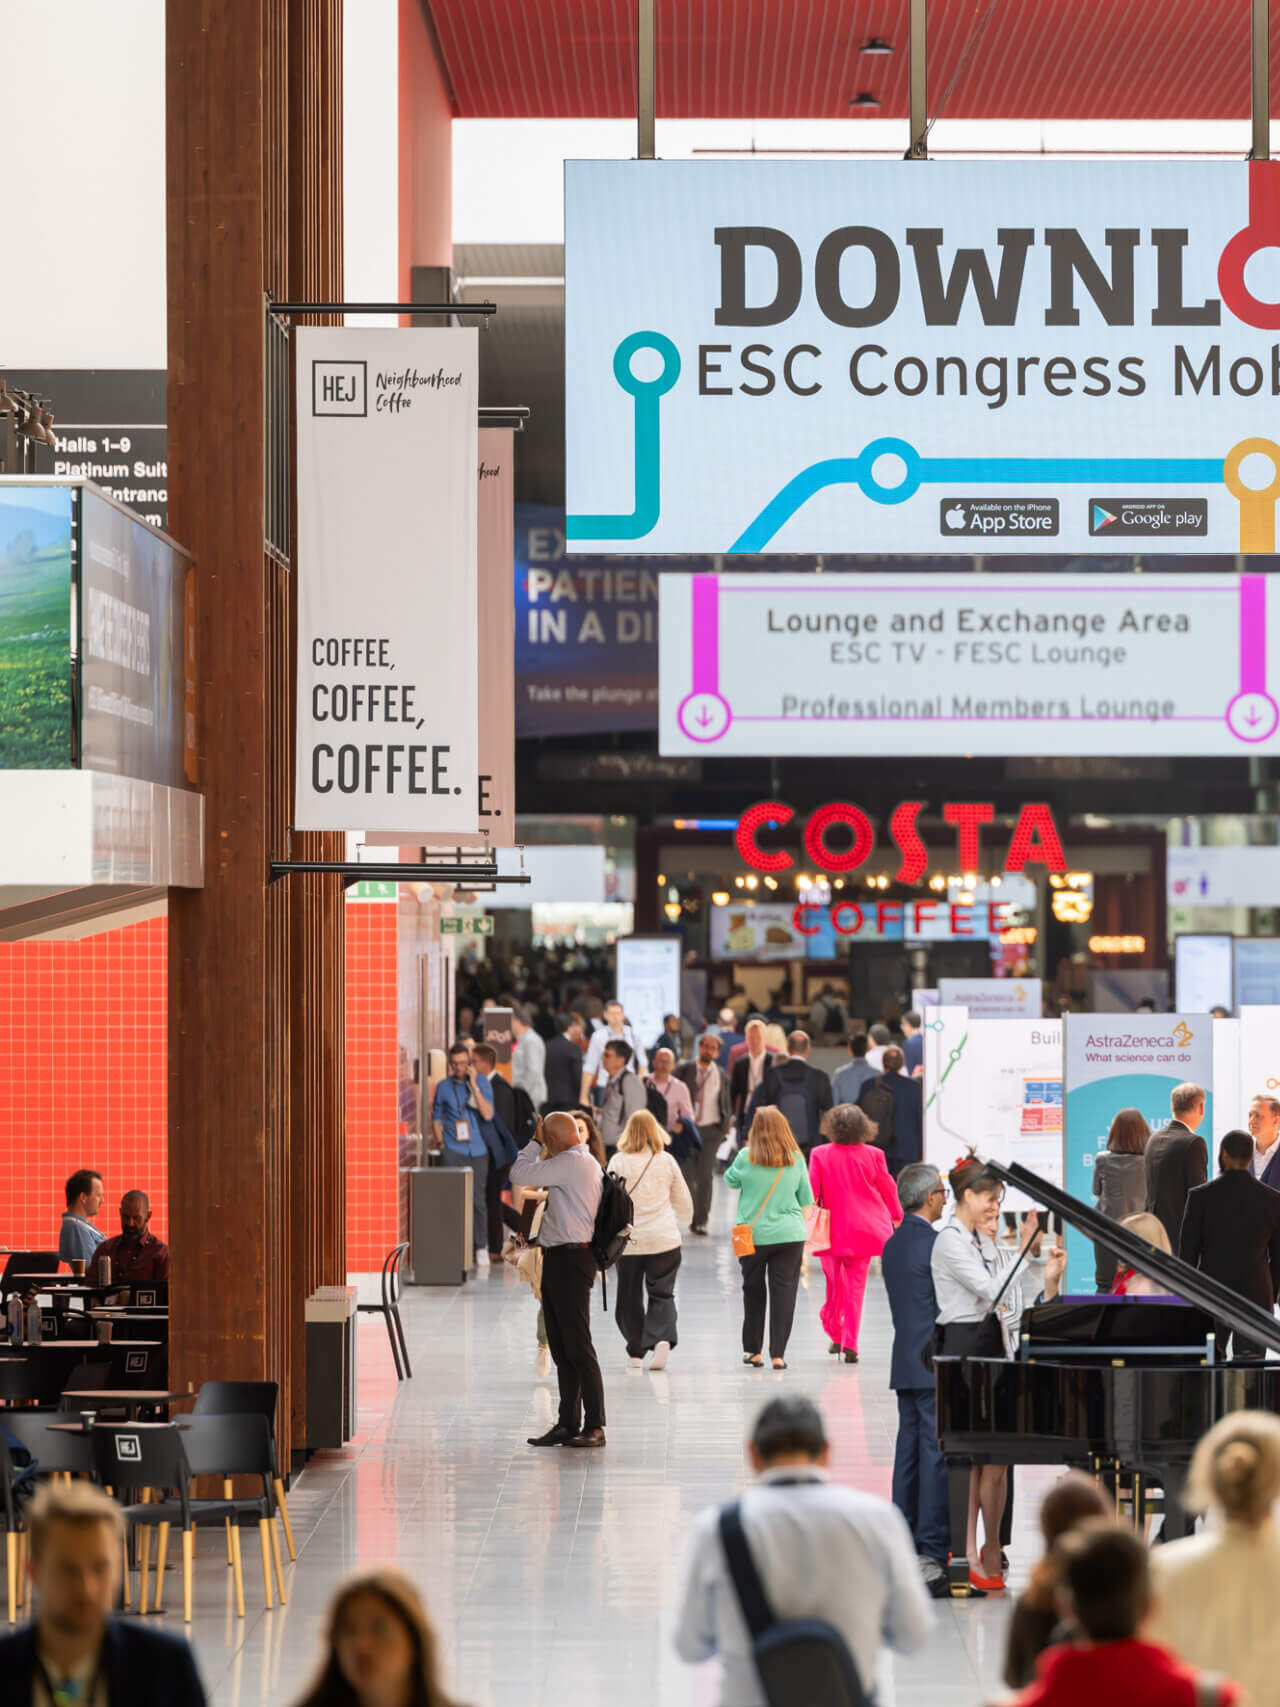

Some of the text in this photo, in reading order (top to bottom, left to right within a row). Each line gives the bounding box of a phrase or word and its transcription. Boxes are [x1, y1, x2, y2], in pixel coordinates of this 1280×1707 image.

[322, 375, 356, 402] HEJ
[375, 367, 463, 391] Neighbourhood
[699, 344, 822, 396] ESC
[849, 344, 1145, 409] Congress
[375, 392, 412, 413] Coffee
[54, 436, 97, 453] Halls
[54, 461, 168, 478] Platinum Suit
[970, 503, 1001, 512] Available
[1013, 503, 1025, 512] the
[1026, 503, 1052, 512] iPhone
[1121, 511, 1202, 528] Google play
[970, 513, 1052, 533] App Store
[527, 609, 566, 644] IN
[578, 610, 605, 644] A
[768, 609, 1190, 638] Lounge and Exchange Area
[312, 637, 395, 671] COFFEE,
[830, 642, 881, 664] ESC
[890, 642, 927, 664] TV
[954, 642, 1022, 664] FESC
[1031, 642, 1127, 668] Lounge
[312, 684, 425, 730] COFFEE,
[527, 685, 562, 701] Take
[565, 685, 588, 701] the
[591, 685, 641, 706] plunge
[782, 694, 1176, 724] Professional Members Lounge
[312, 743, 462, 795] COFFEE.
[735, 802, 1068, 884] COSTA
[792, 900, 1013, 935] COFFEE
[1031, 1031, 1061, 1045] Buil
[1085, 1034, 1174, 1048] AstraZeneca
[1085, 1053, 1191, 1063] What science can do
